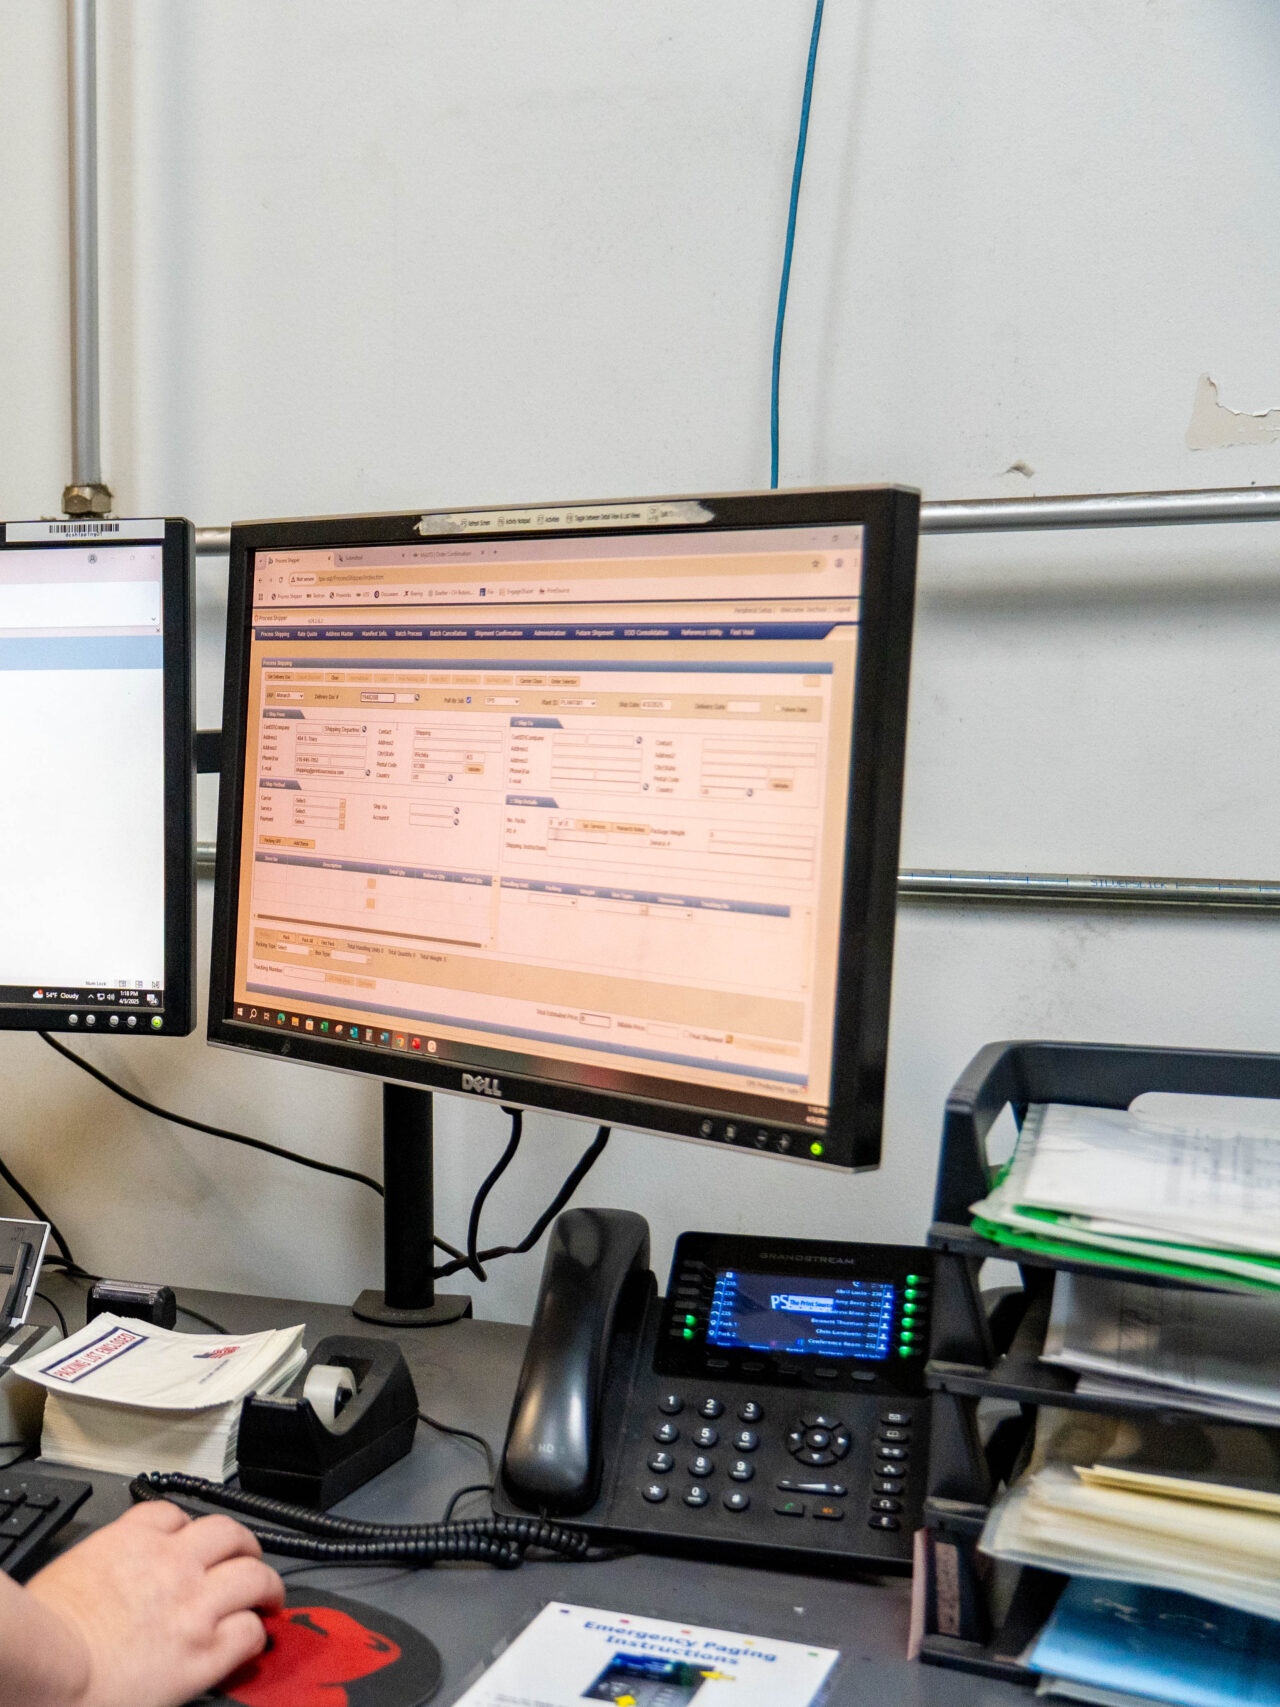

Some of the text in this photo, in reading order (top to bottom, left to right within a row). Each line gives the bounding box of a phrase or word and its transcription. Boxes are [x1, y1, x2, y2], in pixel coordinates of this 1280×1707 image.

[60, 992, 79, 1000] Cloudy
[461, 1072, 502, 1097] DELL
[759, 1252, 855, 1265] GRANDSTREAM
[770, 1294, 789, 1310] PS
[668, 1395, 675, 1405] 1
[706, 1399, 715, 1408] 2
[746, 1402, 755, 1412] 3
[661, 1424, 670, 1433] 4
[701, 1427, 710, 1437] 5
[741, 1431, 750, 1441] 6
[657, 1452, 666, 1462] 7
[696, 1456, 705, 1467] 8
[736, 1461, 746, 1471] 9
[691, 1486, 700, 1496] 0
[583, 1619, 778, 1663] Emergency Paging
[604, 1634, 740, 1666] Instructions
